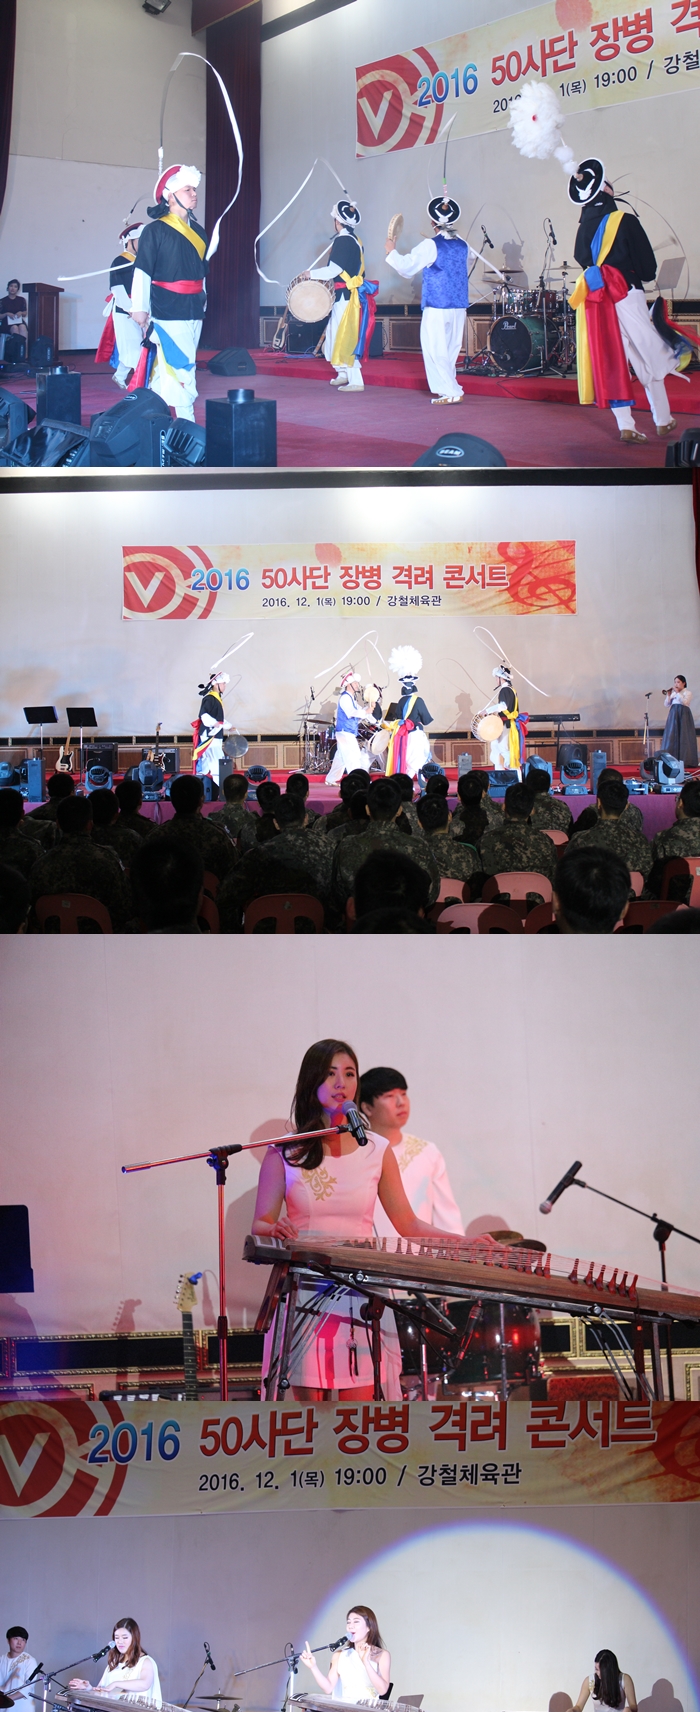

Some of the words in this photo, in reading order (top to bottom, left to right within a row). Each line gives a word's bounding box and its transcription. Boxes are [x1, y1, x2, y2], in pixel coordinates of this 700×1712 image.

[417, 63, 478, 107] 2016
[491, 30, 578, 86] 50사단
[590, 8, 654, 61] 장병
[493, 94, 521, 113] 201
[559, 79, 586, 97] 1(목)
[594, 66, 637, 88] 19:00
[501, 321, 517, 330] Pearl
[191, 568, 250, 591] 2016
[261, 566, 331, 590] 50사단
[339, 565, 382, 590] 장병
[392, 565, 433, 589] 격려
[443, 565, 508, 589] 콘서트
[262, 598, 290, 607] 2016.
[296, 597, 310, 607] 12.
[316, 597, 336, 606] 1(목)
[341, 596, 371, 606] 19:00
[387, 595, 442, 607] 강철체육관
[88, 1420, 181, 1464] 2016
[200, 1408, 318, 1458] 50사단
[333, 1405, 410, 1455] 장병
[429, 1401, 508, 1451] 격려
[526, 1401, 656, 1448] 콘서트
[199, 1473, 245, 1492] 2016.
[255, 1471, 279, 1489] 12.
[290, 1470, 325, 1488] 1(목)
[335, 1467, 387, 1486] 19:00
[417, 1462, 522, 1486] 강철체육관
